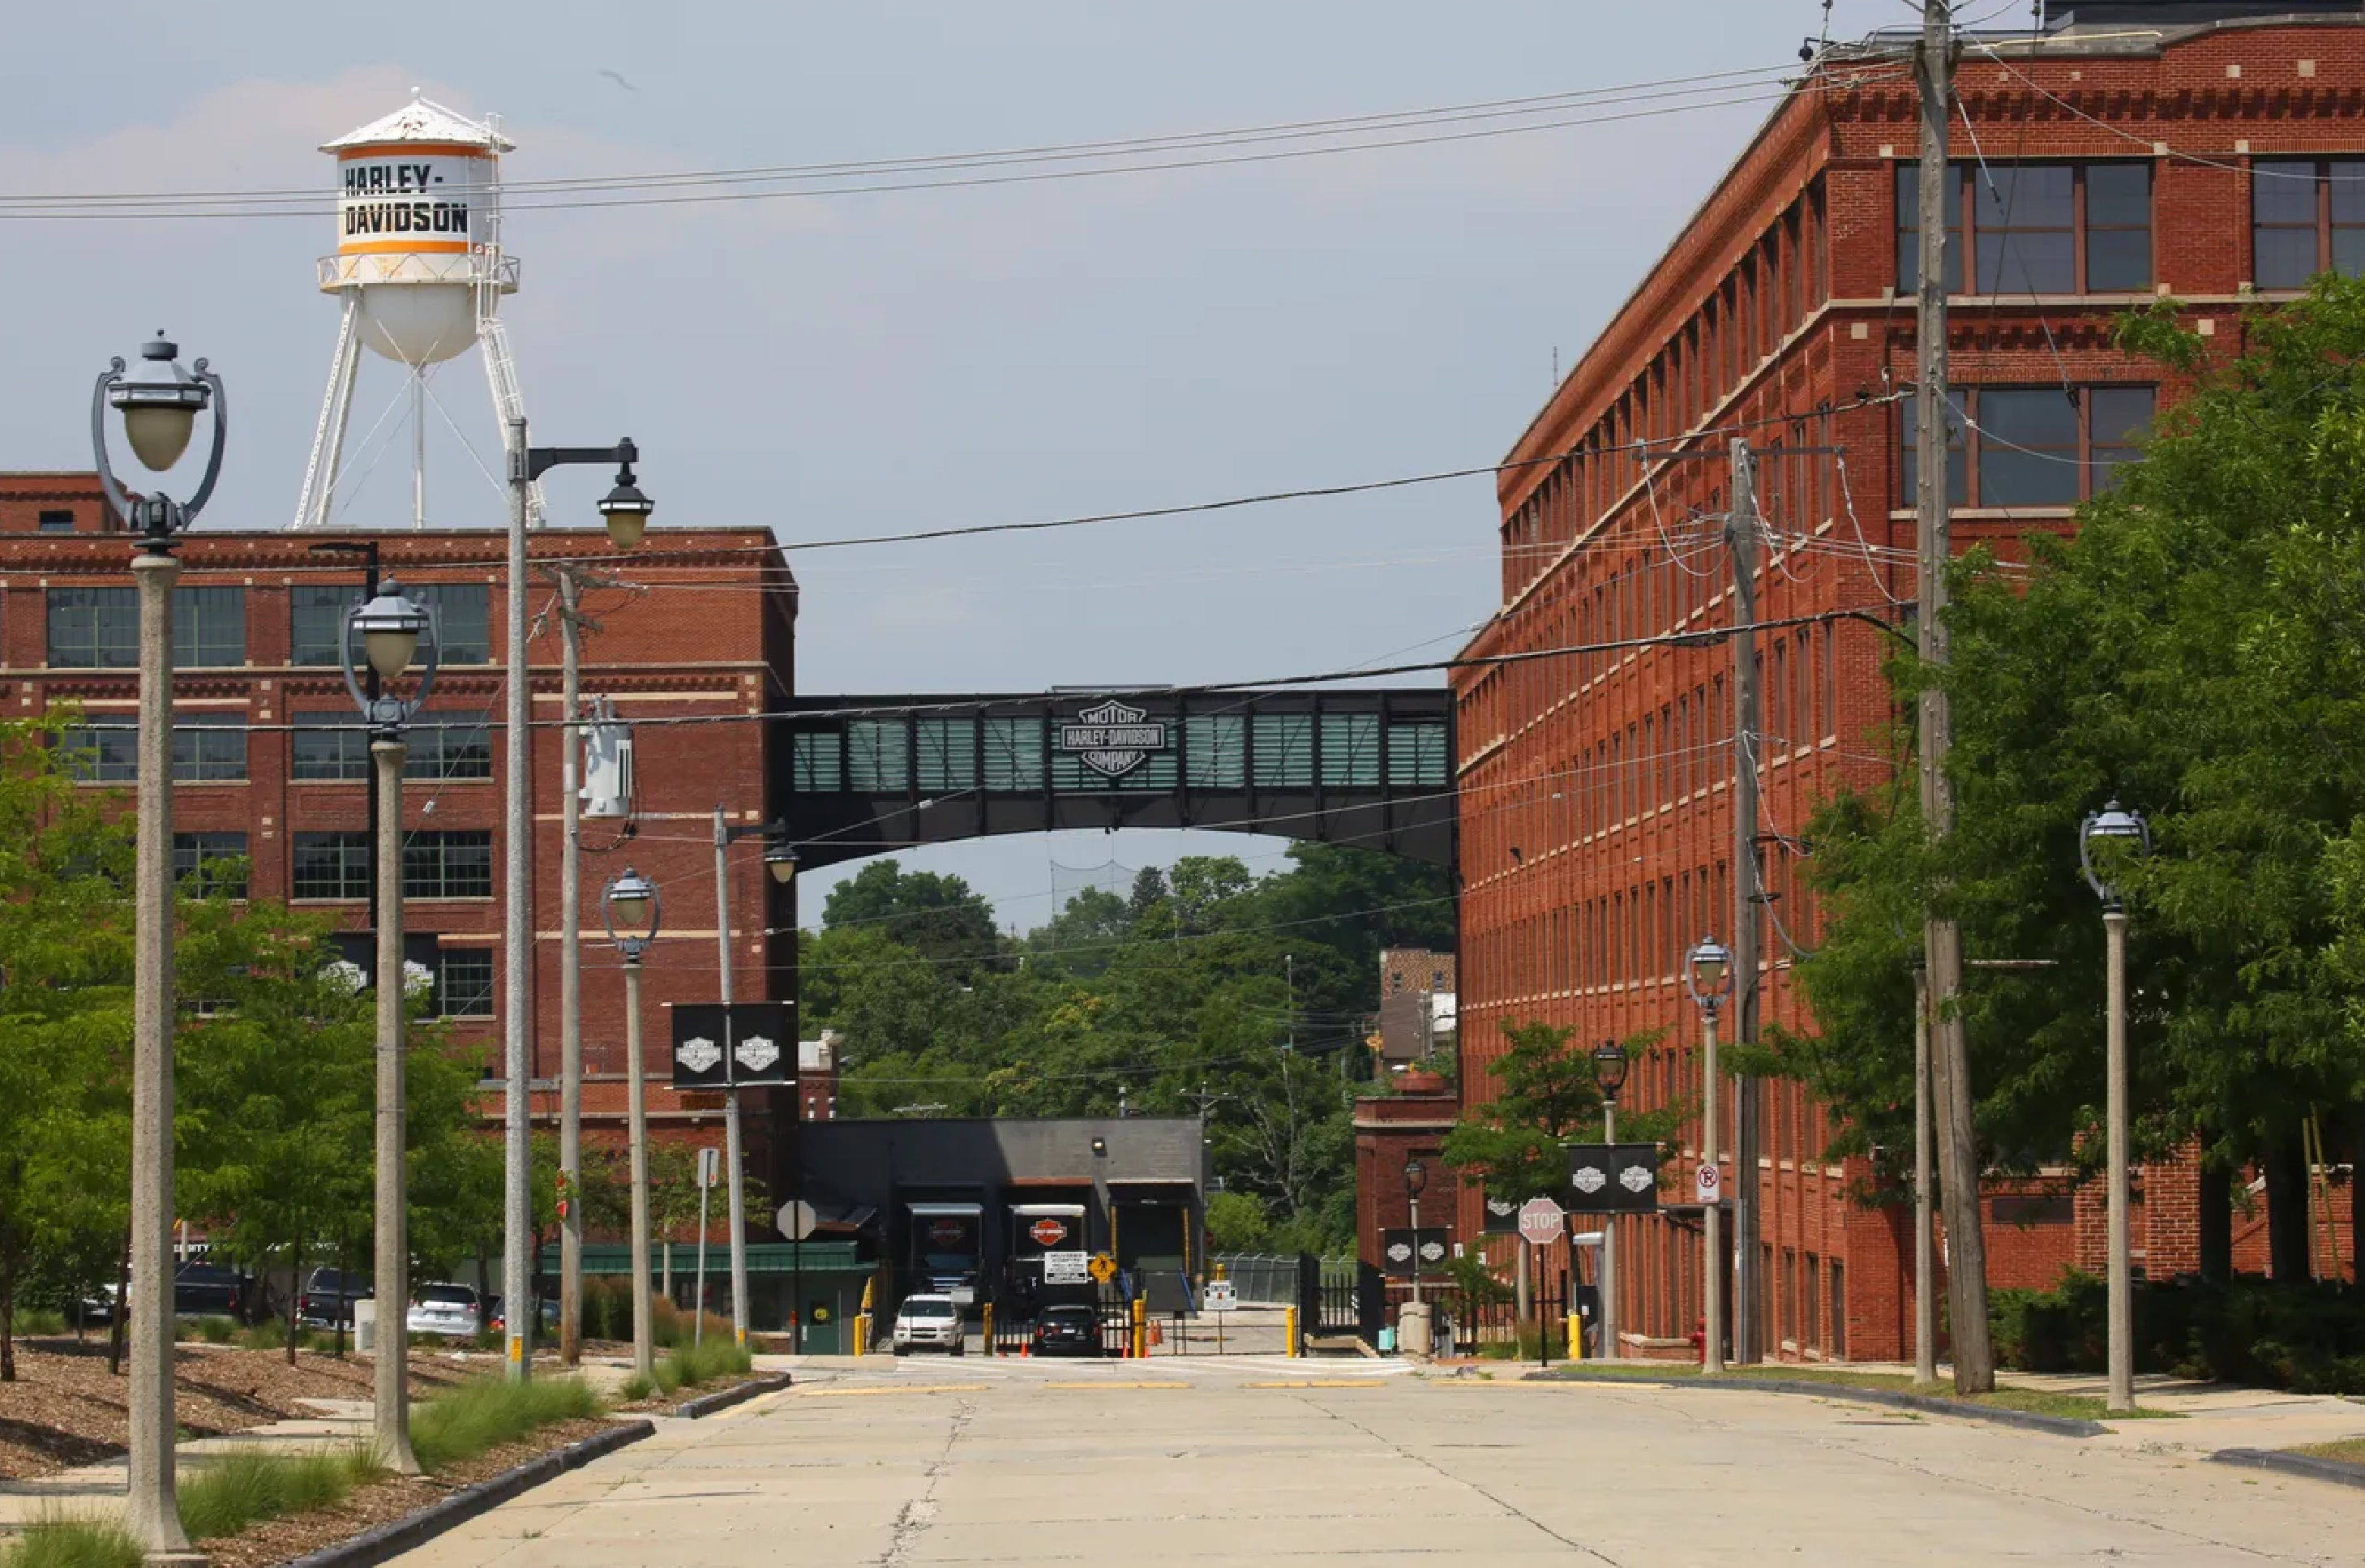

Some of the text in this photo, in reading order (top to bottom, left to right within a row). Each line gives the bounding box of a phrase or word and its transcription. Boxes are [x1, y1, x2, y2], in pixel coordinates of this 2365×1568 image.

[345, 165, 443, 196] HARLEY-
[345, 203, 468, 235] DAVIDSON
[1087, 705, 1138, 723] MOTOR
[1523, 1213, 1559, 1229] STOP
